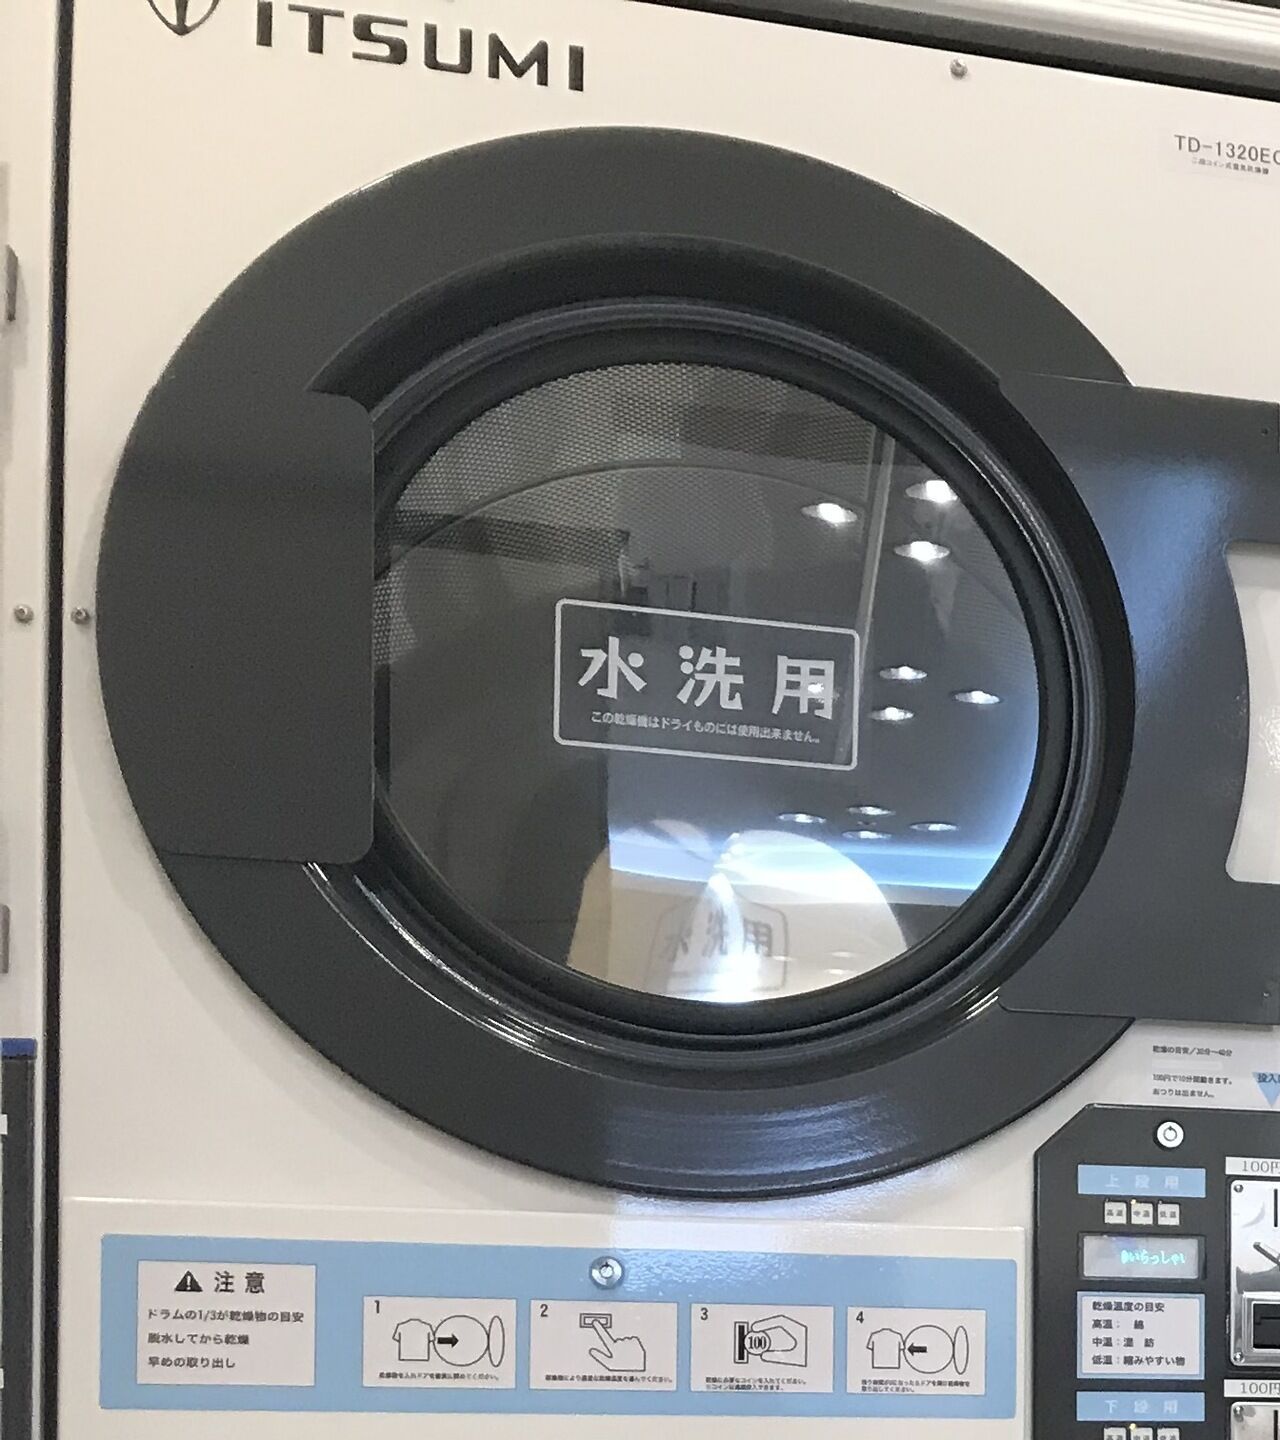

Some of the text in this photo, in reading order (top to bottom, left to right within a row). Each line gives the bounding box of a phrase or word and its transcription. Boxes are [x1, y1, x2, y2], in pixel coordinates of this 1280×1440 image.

[256, 0, 584, 92] ITSUMI
[577, 635, 836, 720] 水洗用
[213, 1270, 266, 1294] 注意
[373, 1300, 380, 1314] 1
[540, 1303, 549, 1318] 2
[700, 1307, 709, 1321] 3
[1092, 1301, 1165, 1313] 乾燥温度の目安
[148, 1308, 305, 1323] ドラムの1/3が乾燥物の目安
[855, 1310, 865, 1324] 4
[147, 1332, 250, 1346] 脱水してから乾燥
[747, 1335, 767, 1350] 100
[147, 1355, 236, 1369] 早めの取り出し
